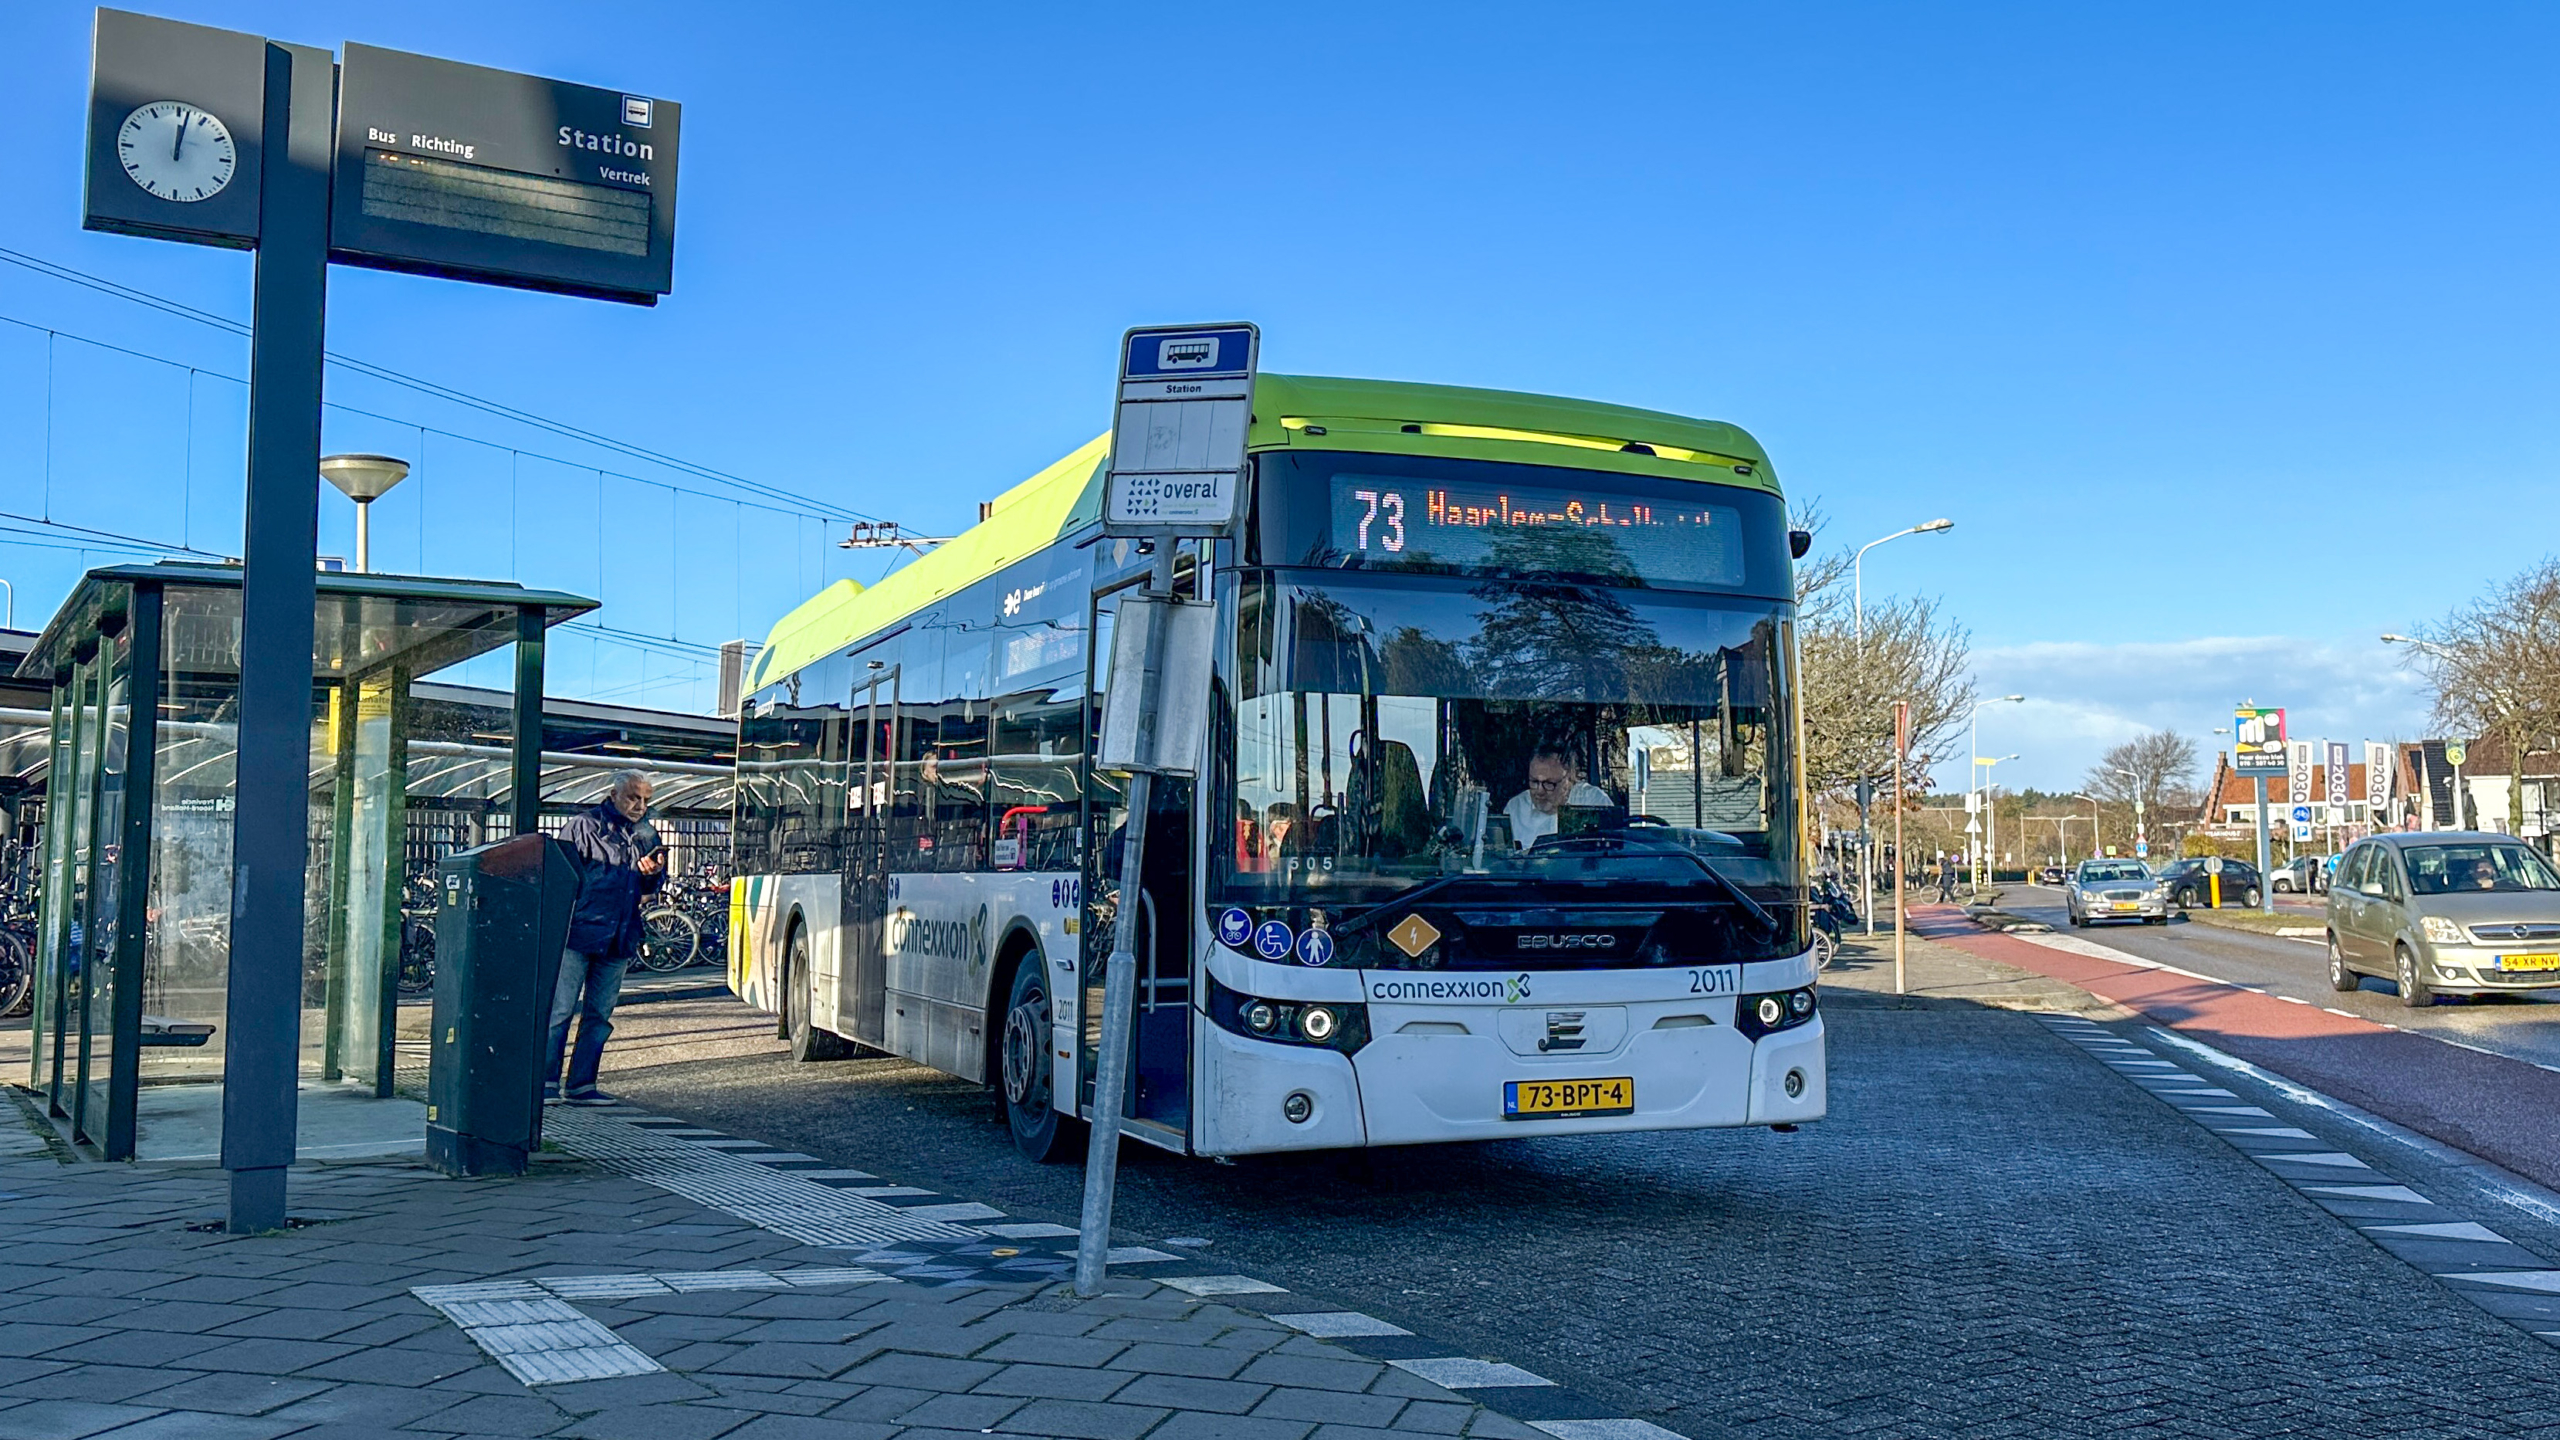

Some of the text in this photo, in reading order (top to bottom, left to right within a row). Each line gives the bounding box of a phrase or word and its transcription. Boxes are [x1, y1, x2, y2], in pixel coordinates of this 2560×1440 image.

[368, 127, 475, 159] Bus Richting
[558, 126, 653, 161] Station
[599, 166, 650, 186] Vertrek
[1165, 384, 1202, 394] Station
[1163, 477, 1219, 499] overal
[1354, 490, 1405, 552] 73
[2292, 765, 2309, 803] 2030
[2330, 765, 2347, 806] 2030
[2369, 767, 2386, 806] 2030
[1290, 856, 1333, 870] 505
[892, 918, 968, 961] connexxion
[1518, 934, 1616, 950] EBUSCO
[1372, 980, 1505, 999] connexxion
[1687, 968, 1735, 993] 2011
[1057, 999, 1074, 1022] 2011
[1507, 1082, 1623, 1109] NL 73-BPT-4
